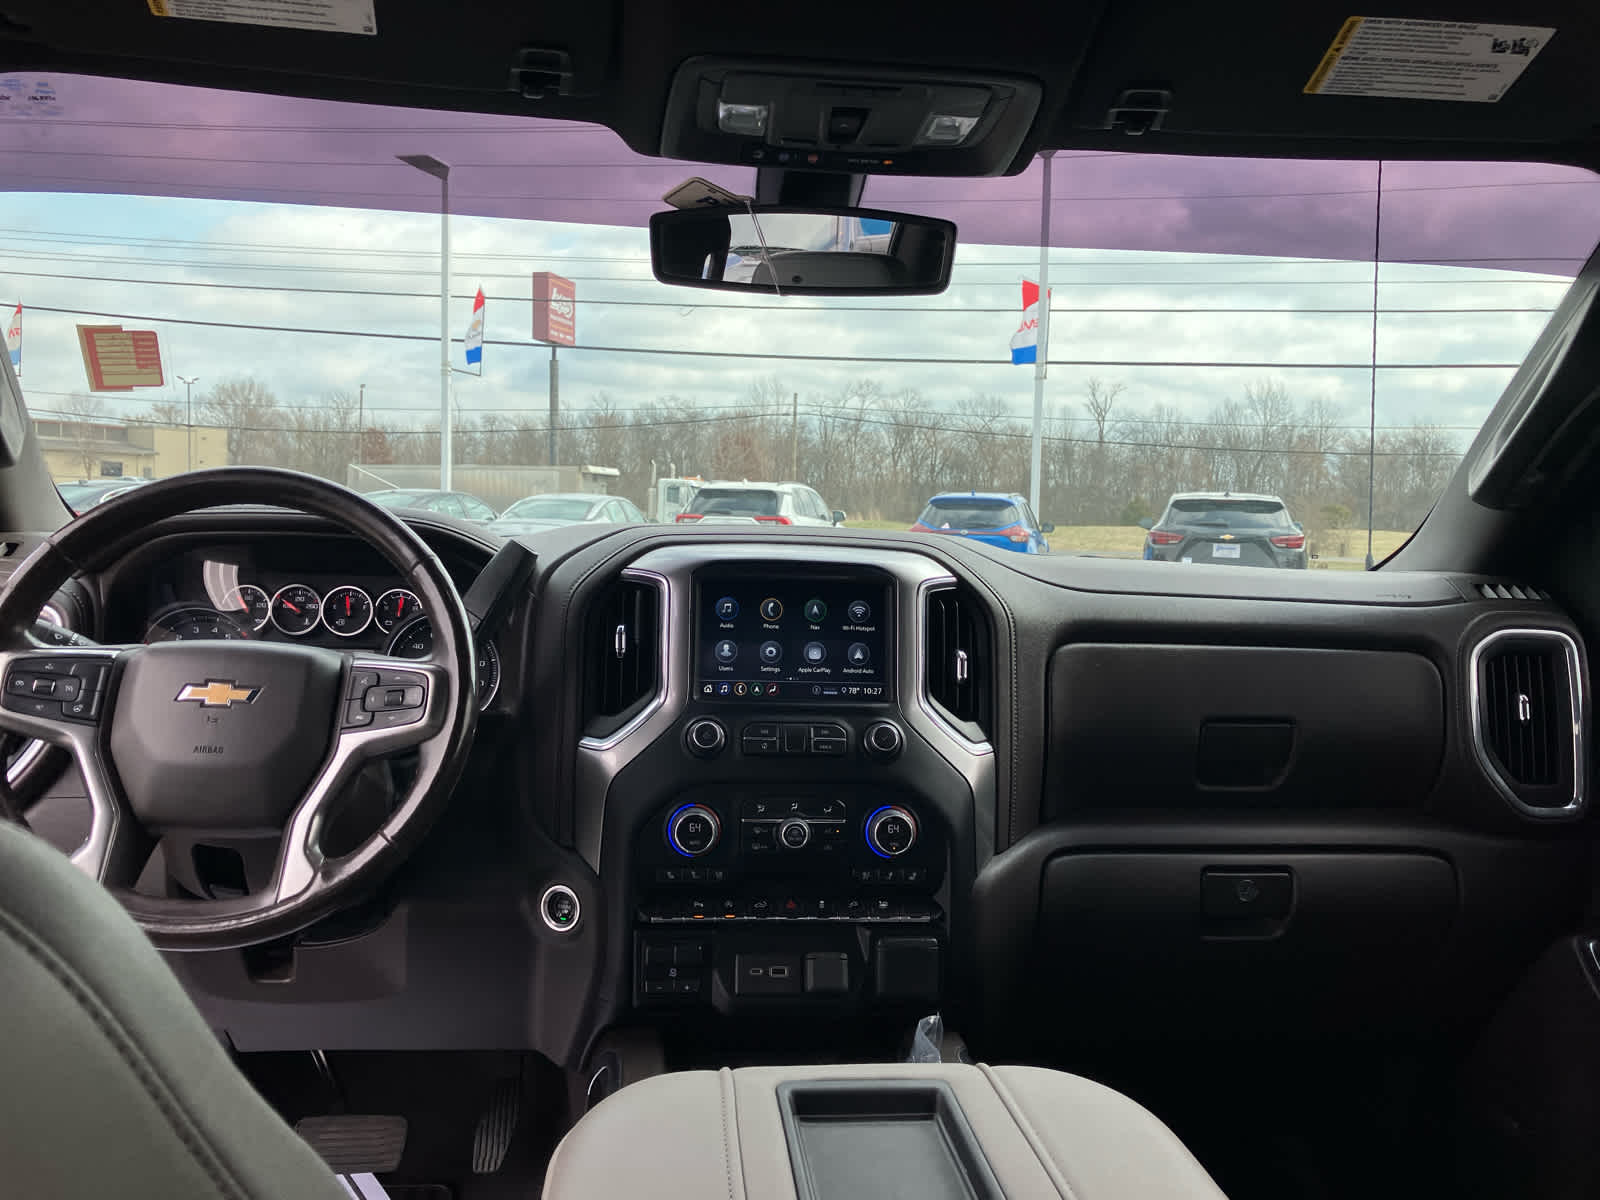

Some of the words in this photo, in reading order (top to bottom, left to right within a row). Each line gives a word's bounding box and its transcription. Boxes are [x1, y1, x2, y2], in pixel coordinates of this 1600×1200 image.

[760, 665, 781, 673] Settings
[798, 666, 812, 674] Apple
[813, 666, 831, 675] CarPlay
[863, 687, 882, 695] 10:27
[193, 745, 224, 754] AIRBAG
[688, 823, 702, 833] 64
[887, 823, 900, 834] 64
